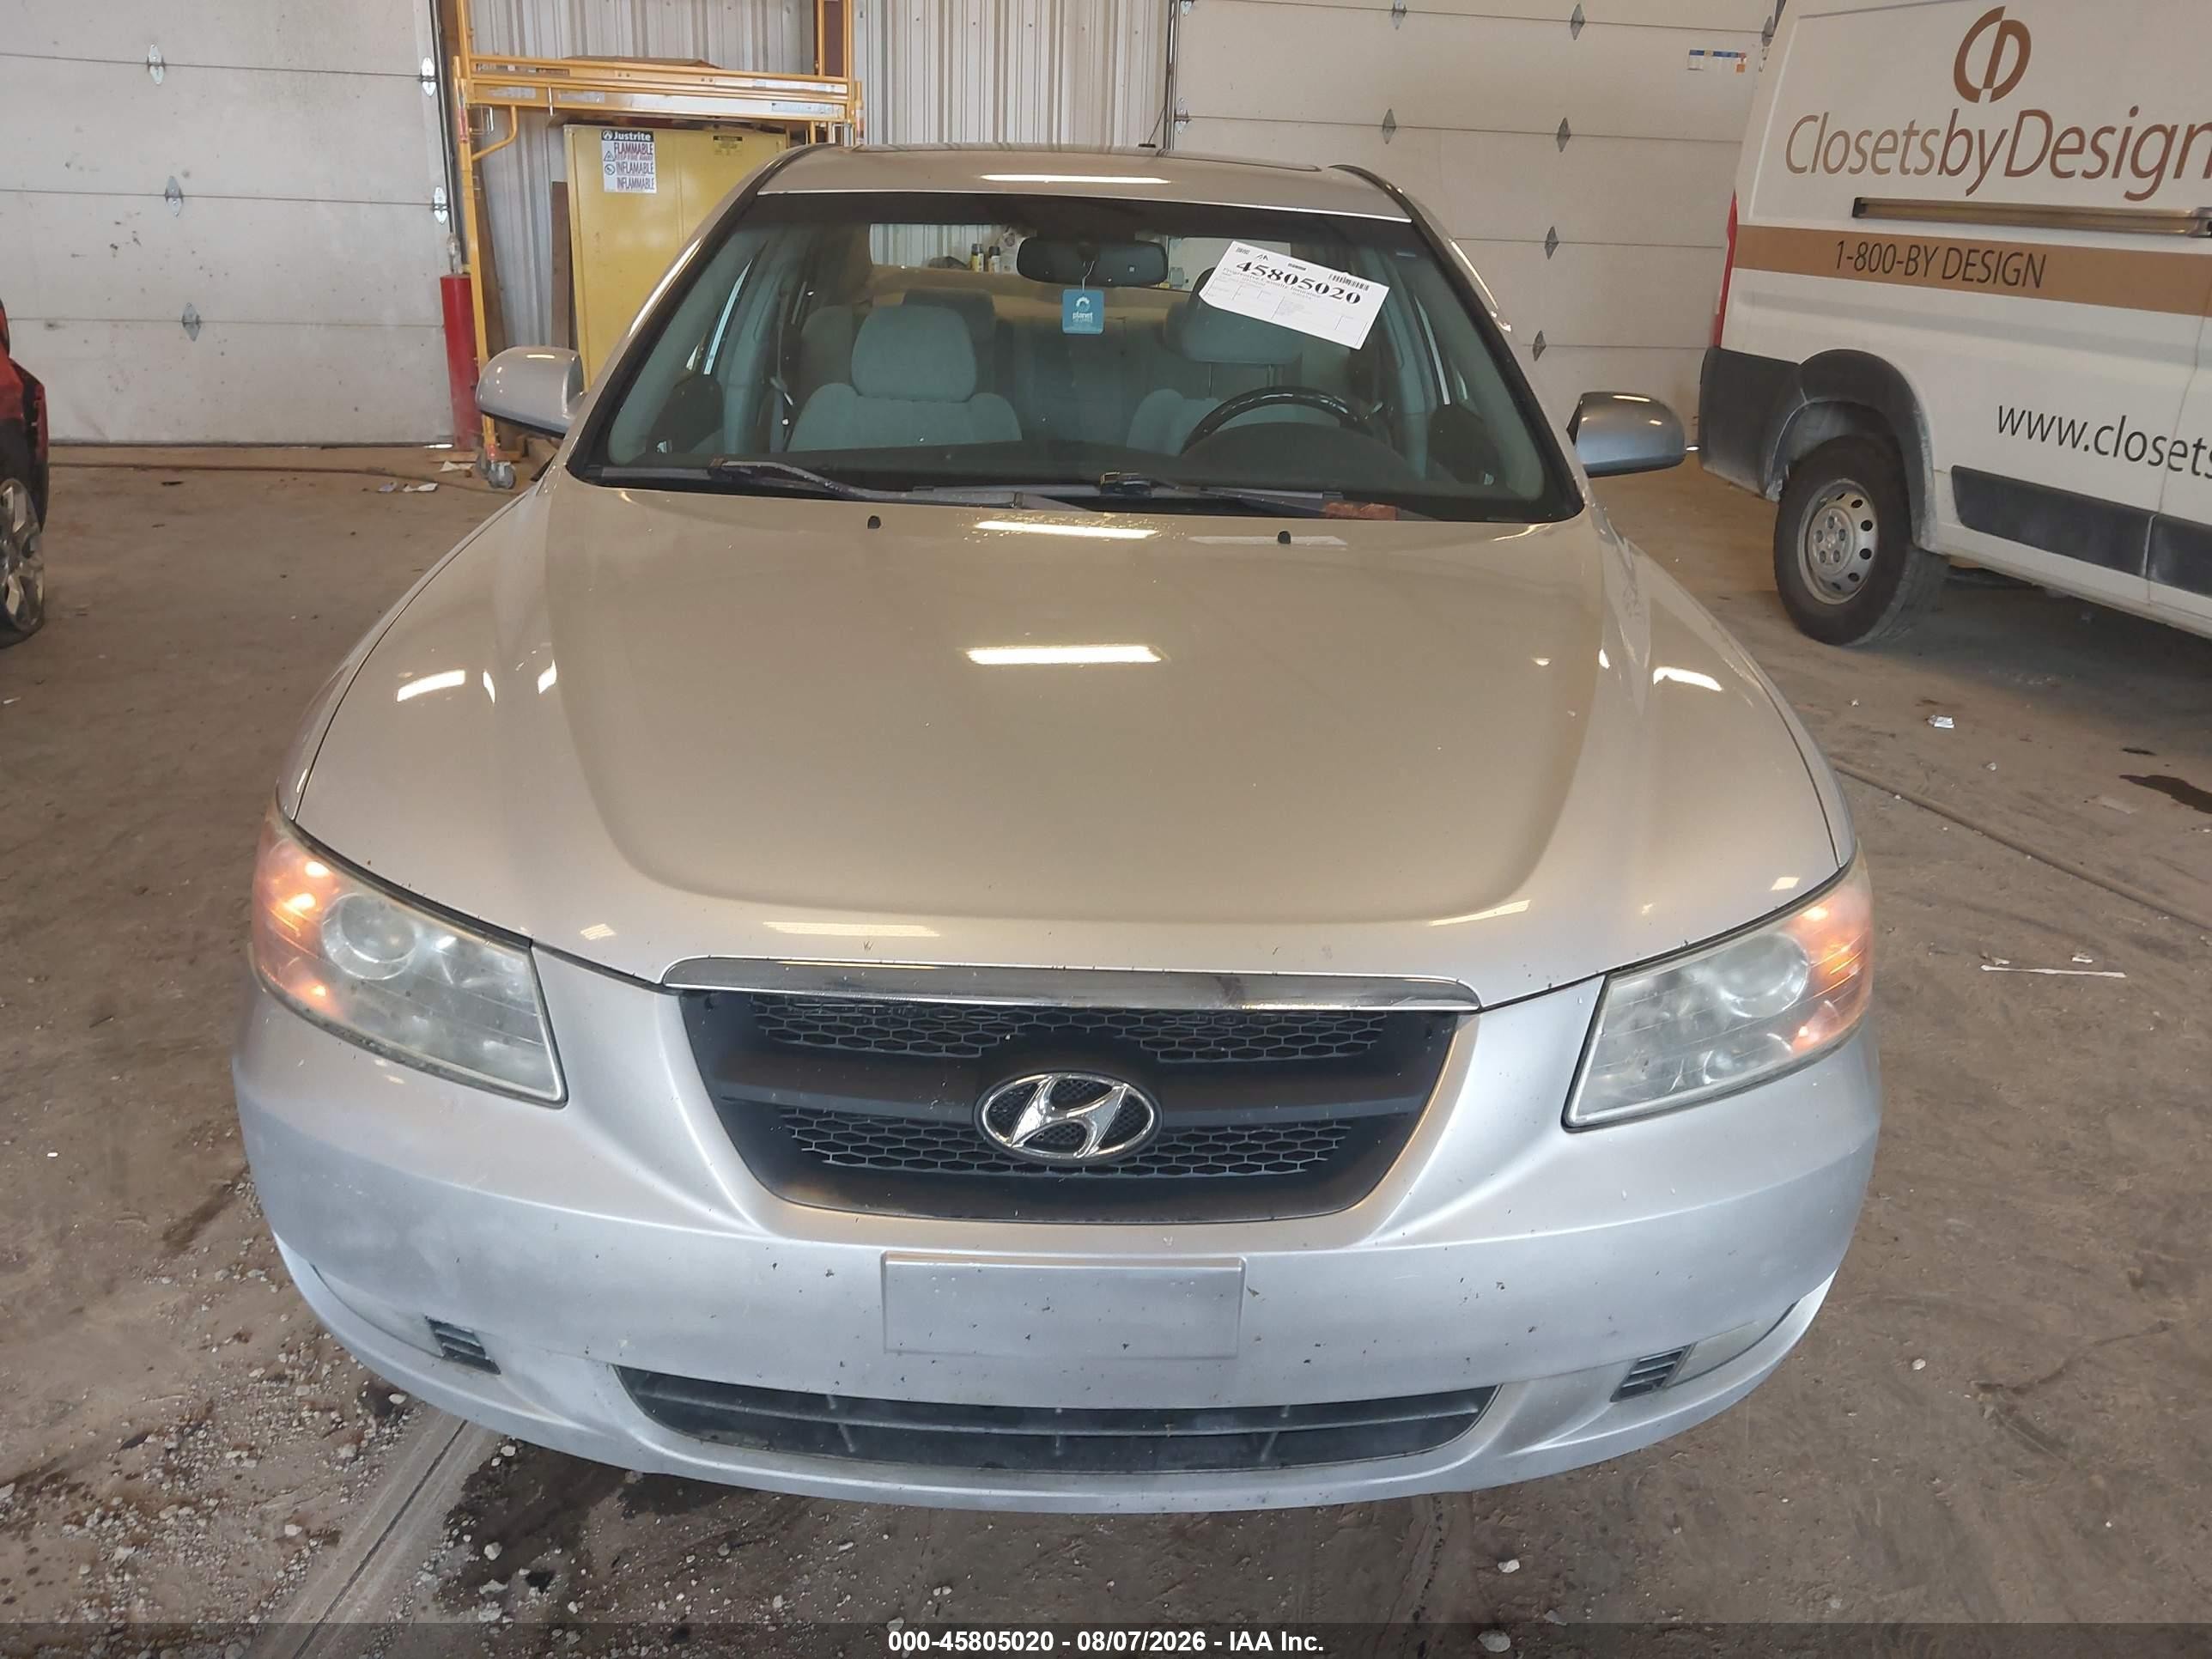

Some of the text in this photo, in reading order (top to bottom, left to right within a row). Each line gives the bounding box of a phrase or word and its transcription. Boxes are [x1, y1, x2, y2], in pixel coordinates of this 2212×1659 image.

[613, 131, 652, 142] Justrite
[614, 142, 653, 155] FLAMMABLE
[616, 161, 654, 174] INFLAMABLE
[1835, 240, 2047, 289] 1-800-BY DESIGN
[1236, 260, 1362, 305] 45805020
